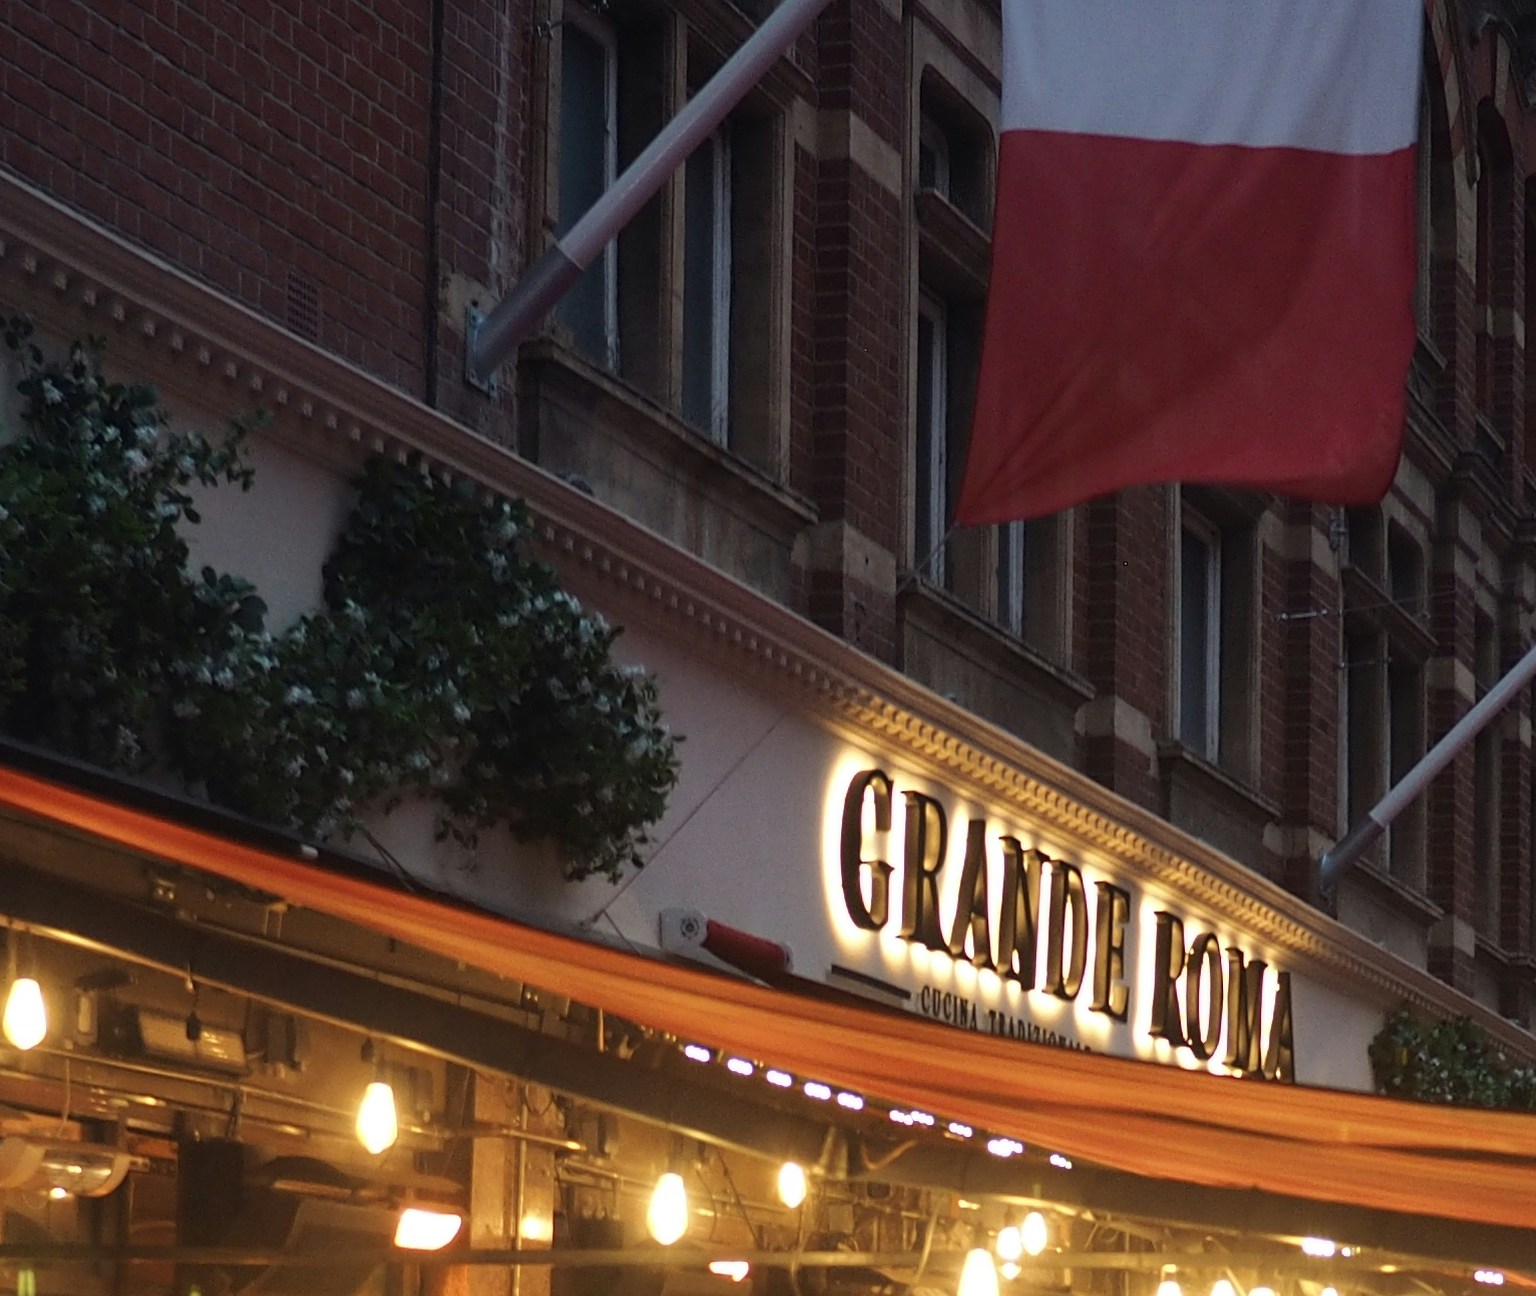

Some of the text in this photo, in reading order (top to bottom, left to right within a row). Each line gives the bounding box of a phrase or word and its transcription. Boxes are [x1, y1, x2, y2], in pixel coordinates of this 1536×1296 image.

[840, 768, 1296, 1084] GRANDE ROMA
[921, 985, 978, 1032] CUCINA
